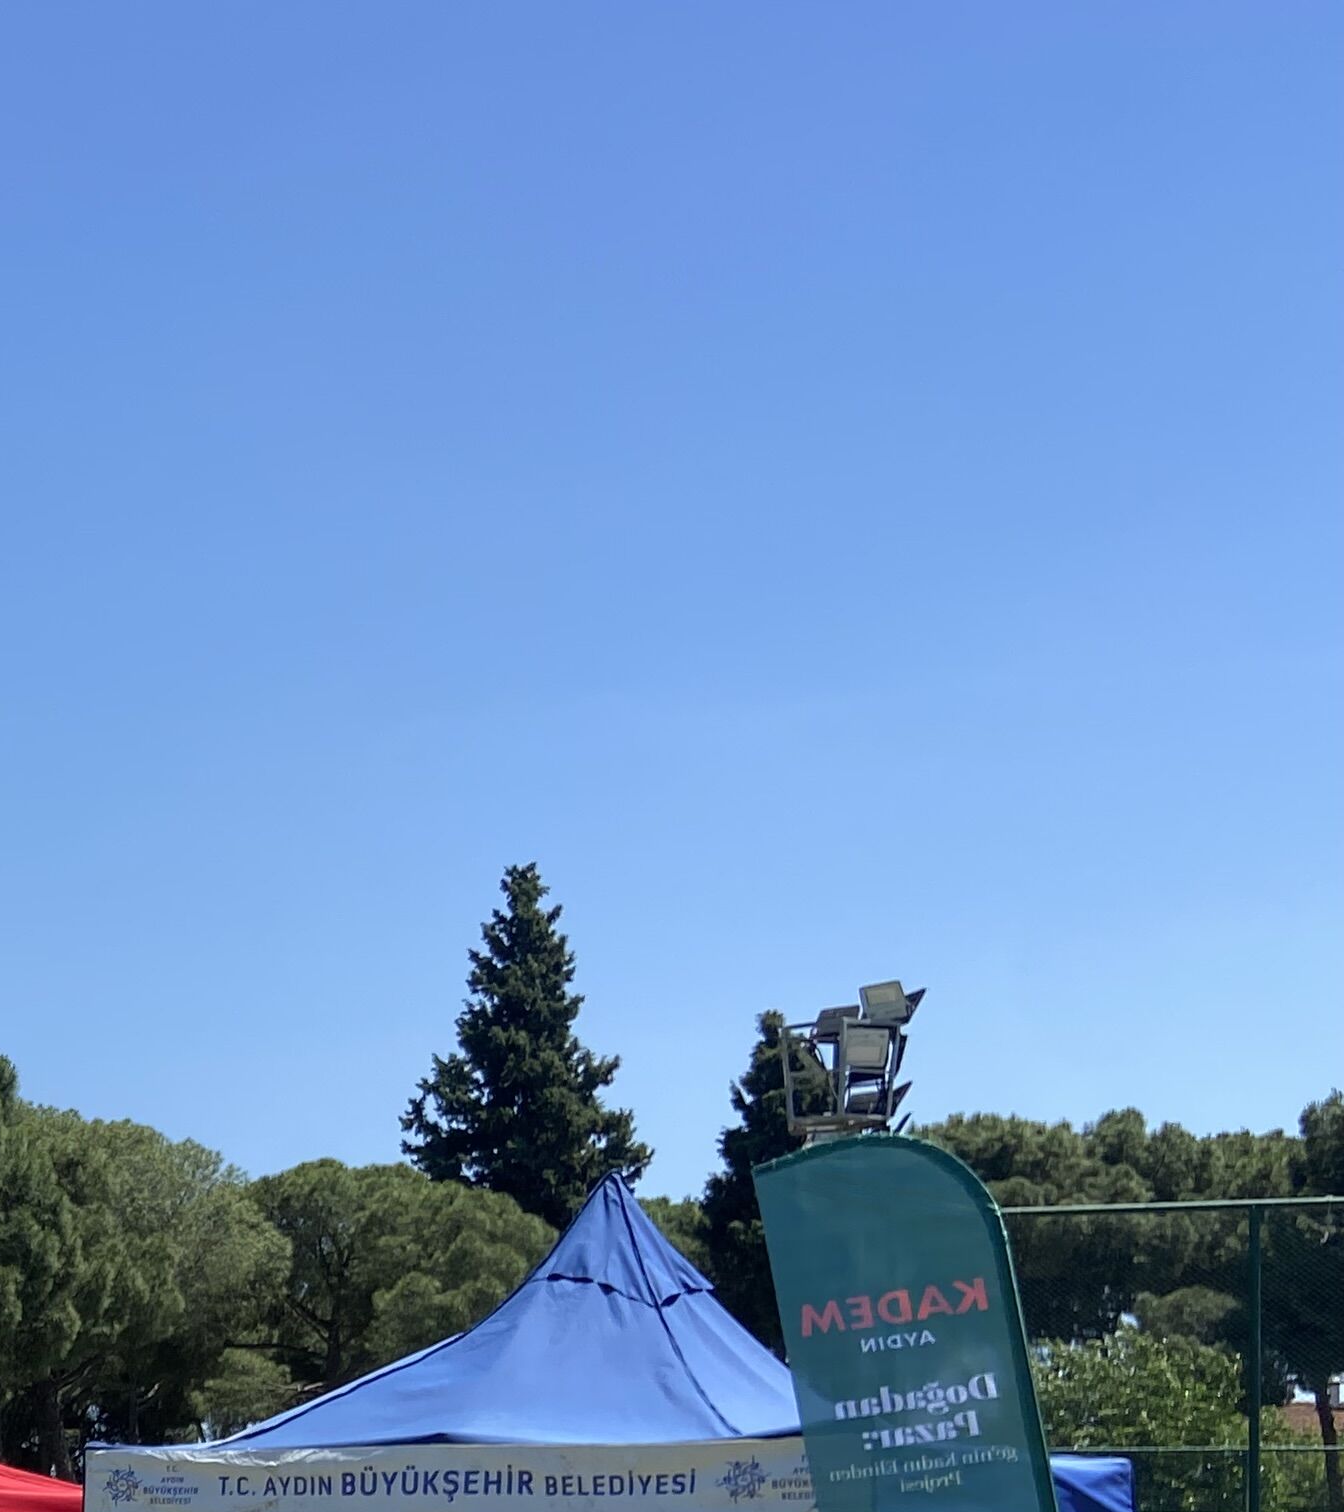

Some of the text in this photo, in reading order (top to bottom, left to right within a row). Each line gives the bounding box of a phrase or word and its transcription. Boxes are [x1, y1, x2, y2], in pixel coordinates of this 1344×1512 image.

[218, 1465, 696, 1502] T.C. AYDIN BÜYÜKŞEHİR BELEDİYESİ
